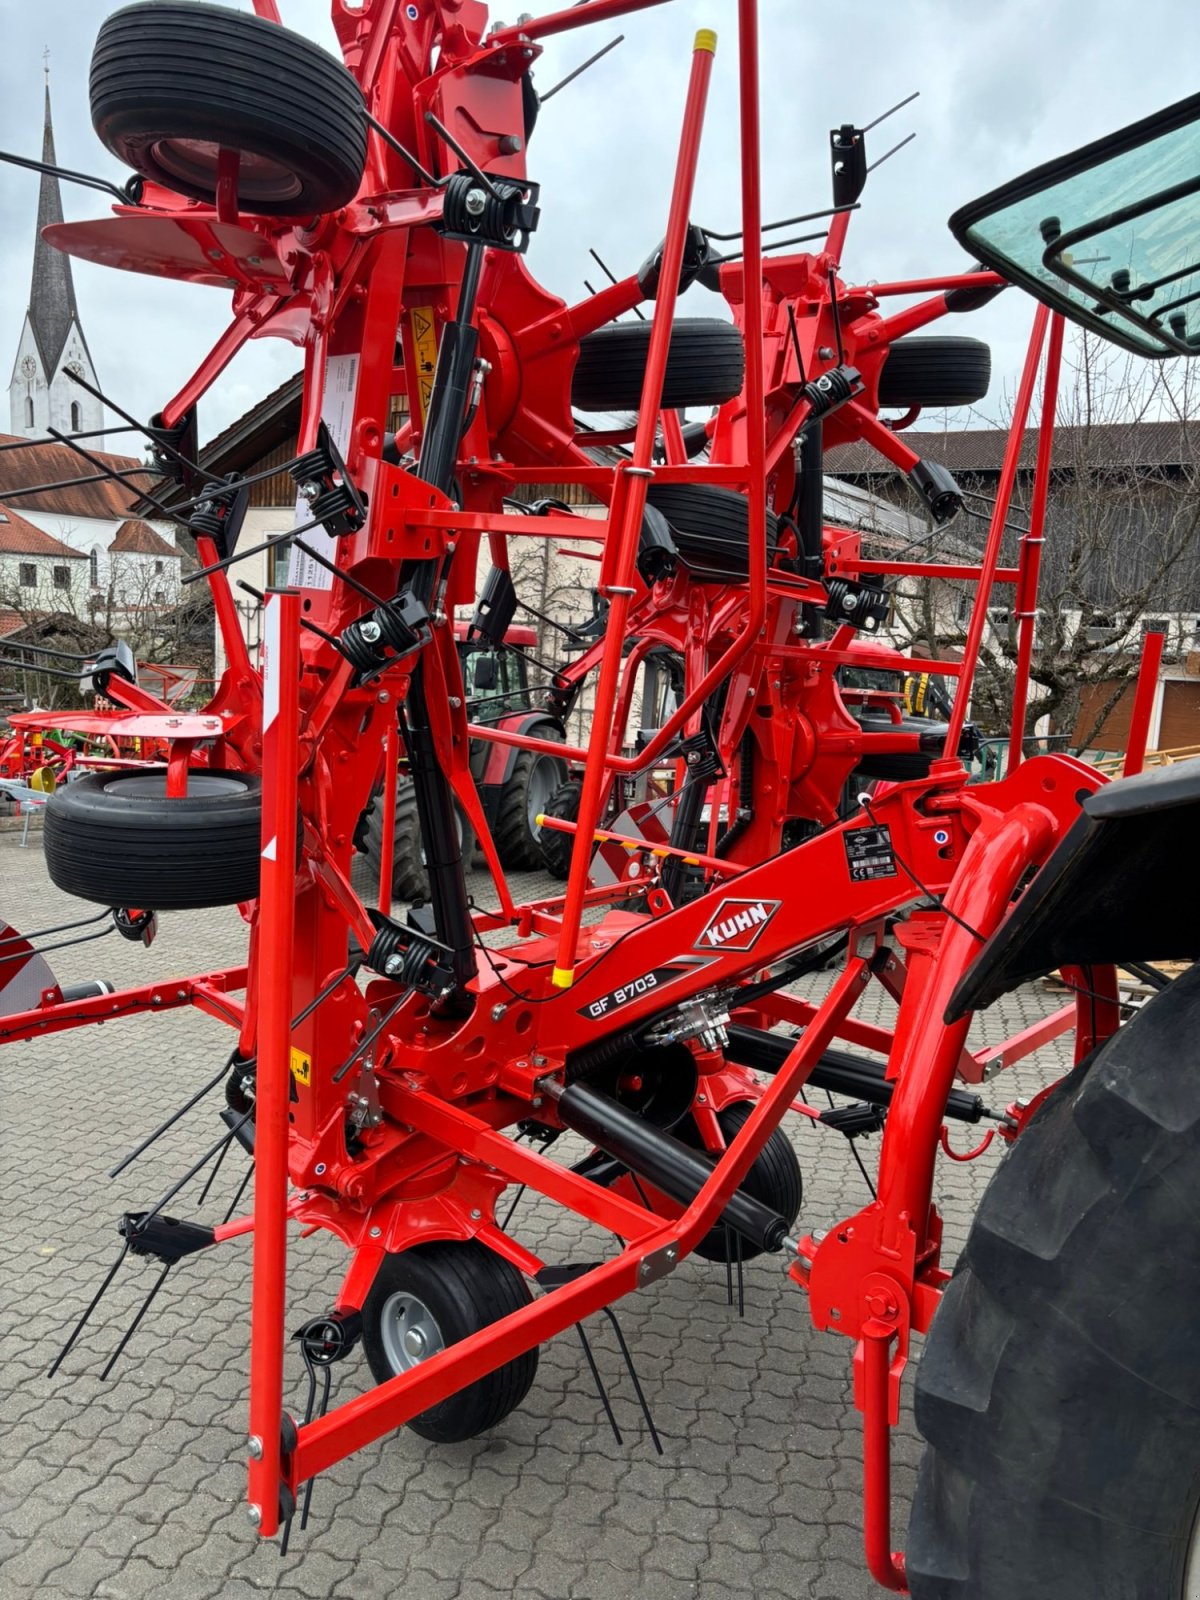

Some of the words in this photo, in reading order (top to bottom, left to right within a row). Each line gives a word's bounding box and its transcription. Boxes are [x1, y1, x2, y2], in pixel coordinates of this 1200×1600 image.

[706, 902, 768, 946] KUHN
[589, 997, 609, 1016] GF
[614, 973, 657, 1003] 8703
